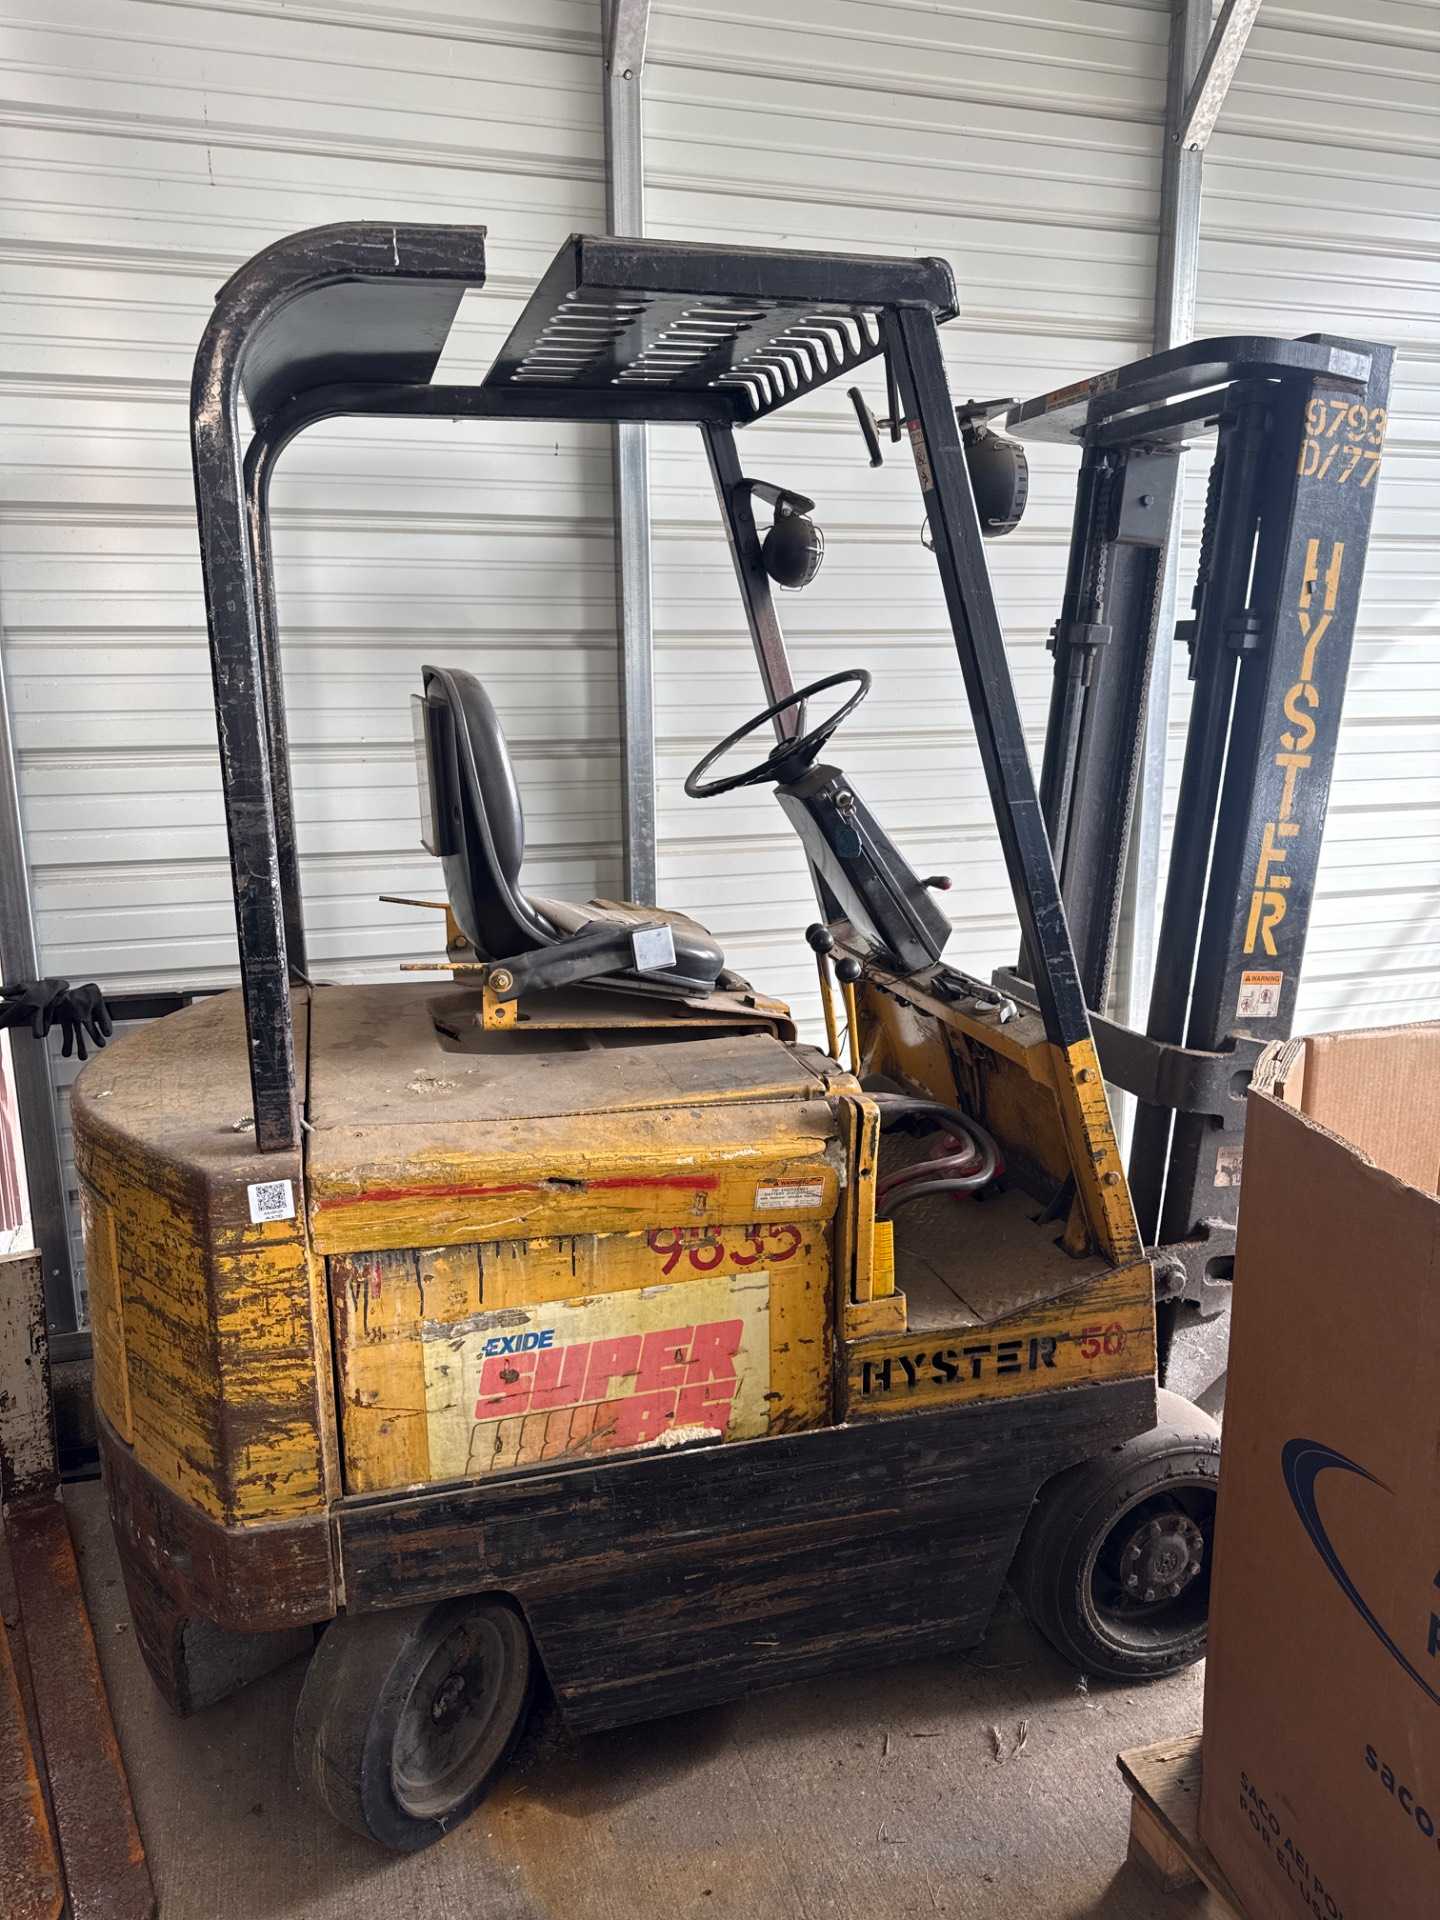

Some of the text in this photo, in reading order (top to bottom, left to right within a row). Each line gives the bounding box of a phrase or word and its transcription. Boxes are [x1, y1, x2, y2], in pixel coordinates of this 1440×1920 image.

[1305, 398, 1387, 445] 9793
[1297, 439, 1381, 488] D/77
[1243, 538, 1345, 956] HYSTER
[475, 1319, 745, 1420] SUPER
[482, 1328, 555, 1357] EXIDE
[862, 1321, 1127, 1396] HYSTER 50
[1239, 1793, 1271, 1848] POR
[1240, 1771, 1280, 1836] SACO
[1284, 1837, 1309, 1879] AEI
[1365, 1744, 1440, 1853] saco
